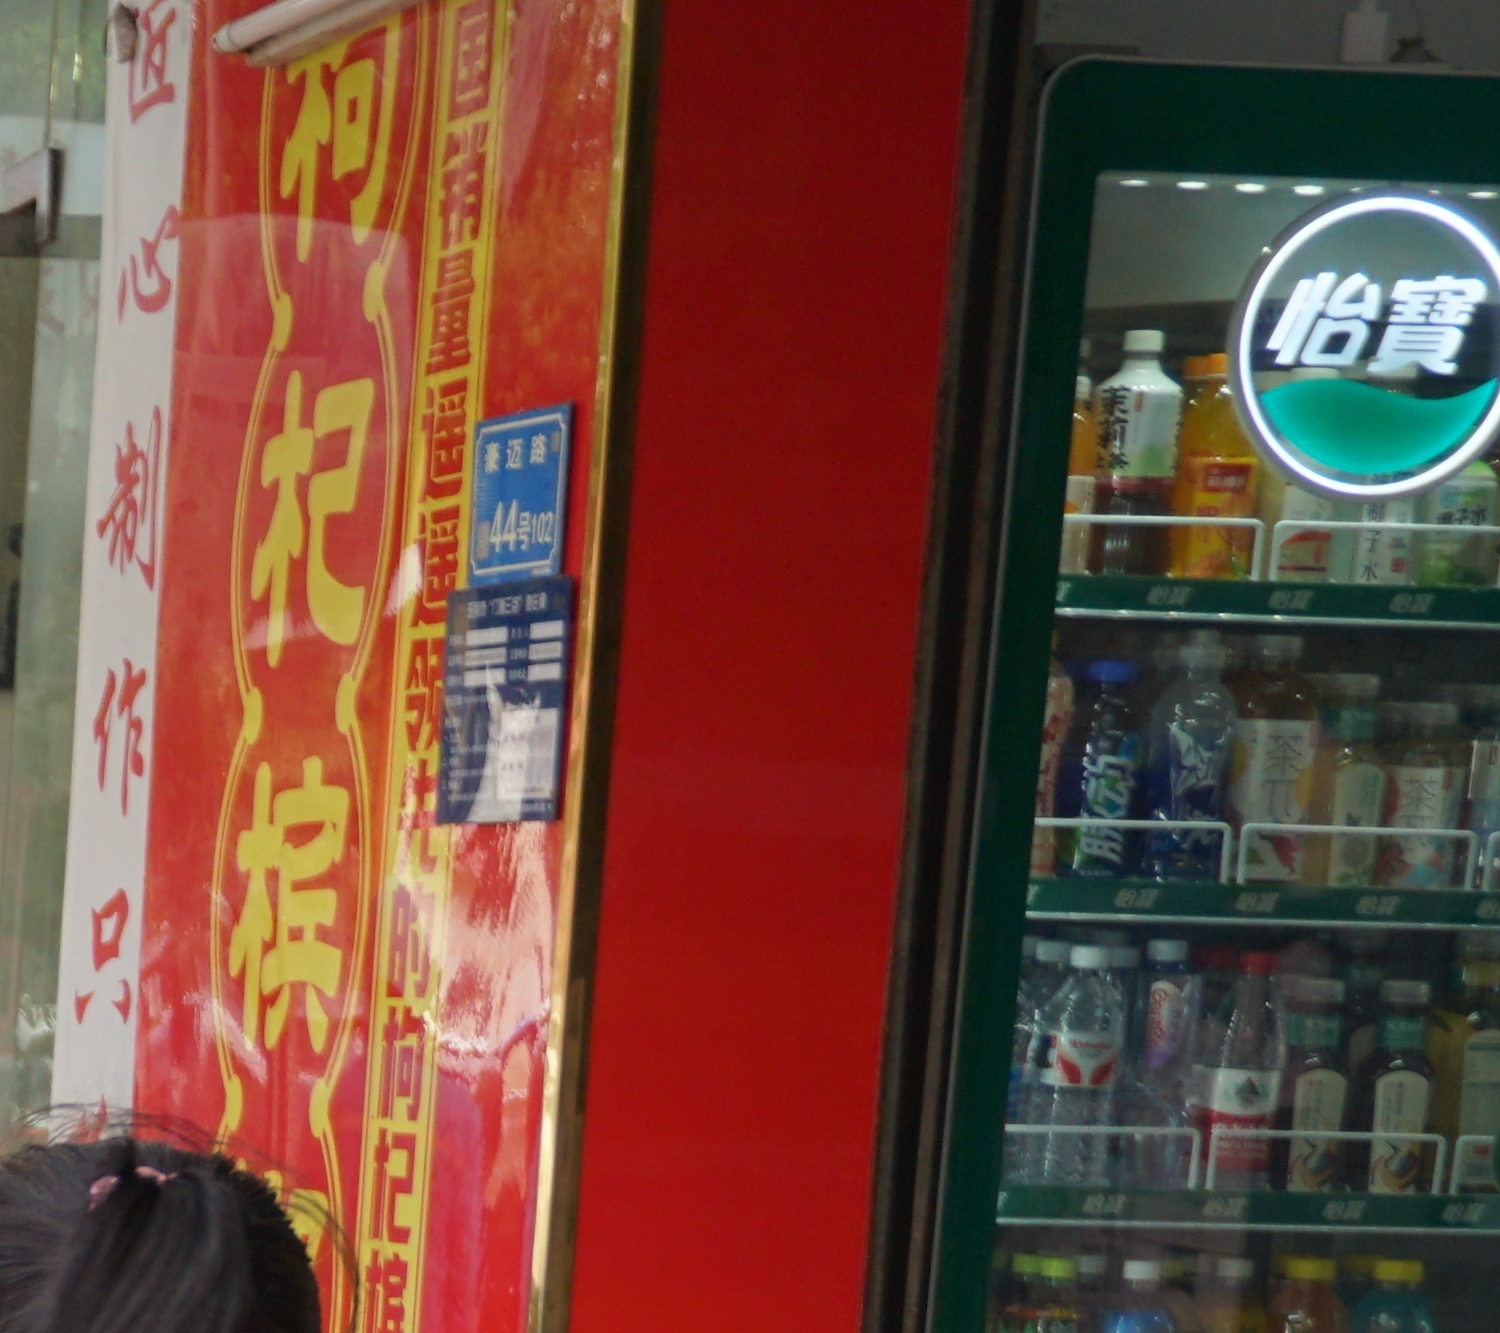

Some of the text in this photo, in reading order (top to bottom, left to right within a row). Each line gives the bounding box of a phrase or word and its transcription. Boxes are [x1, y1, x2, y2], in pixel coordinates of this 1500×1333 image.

[1266, 271, 1488, 376] 怡寶
[485, 433, 548, 473] 豪迈路
[75, 0, 181, 1128] 匠心制作只
